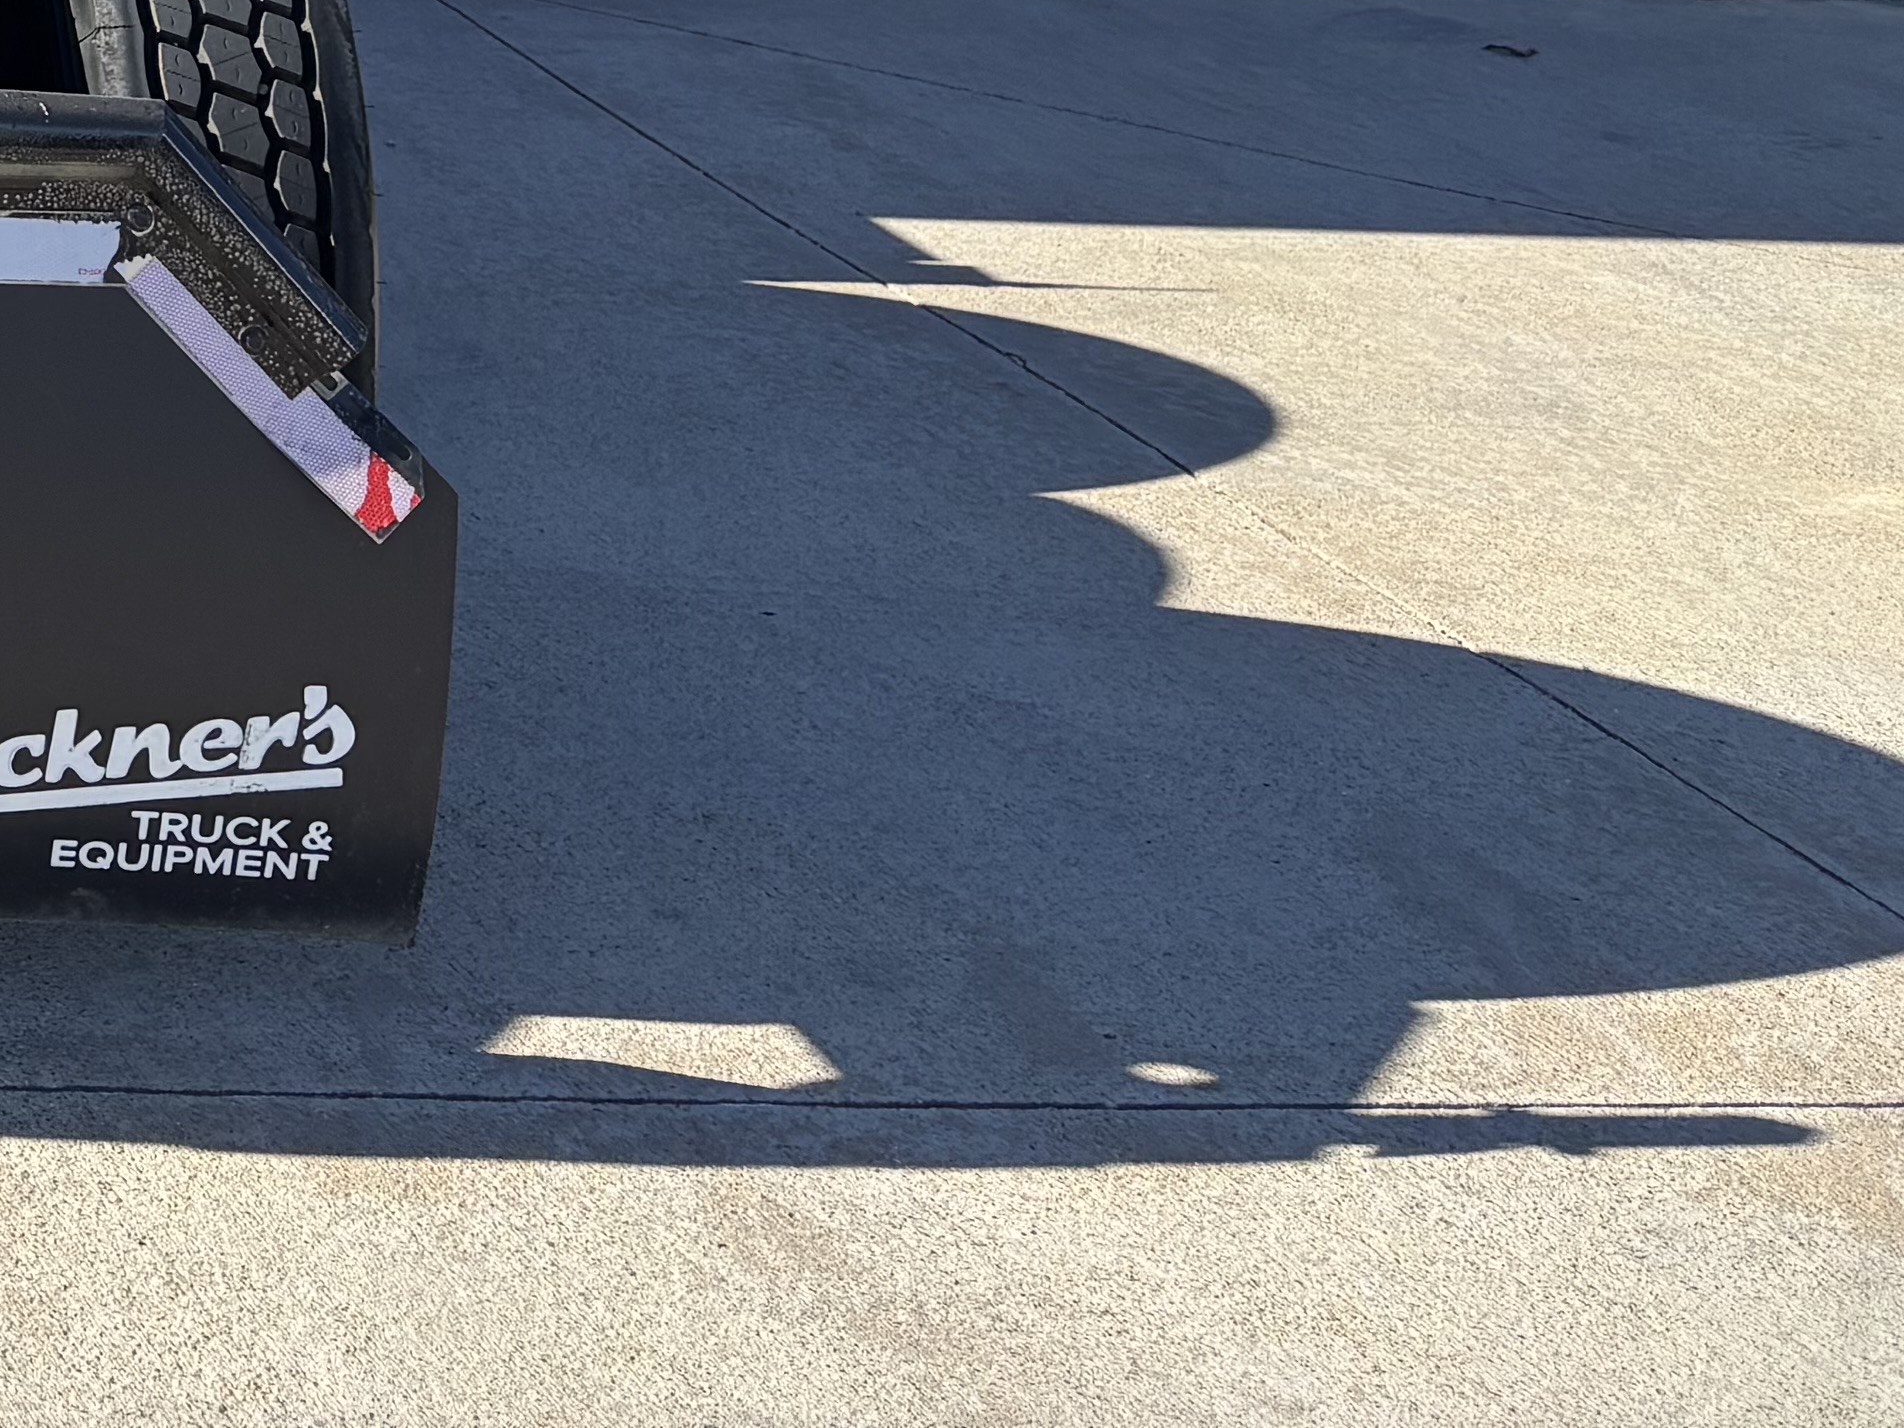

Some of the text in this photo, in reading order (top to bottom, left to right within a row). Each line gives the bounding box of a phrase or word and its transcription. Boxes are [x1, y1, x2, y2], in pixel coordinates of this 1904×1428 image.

[130, 809, 333, 852] TRUCK &
[49, 839, 331, 882] EQUIPMENT
